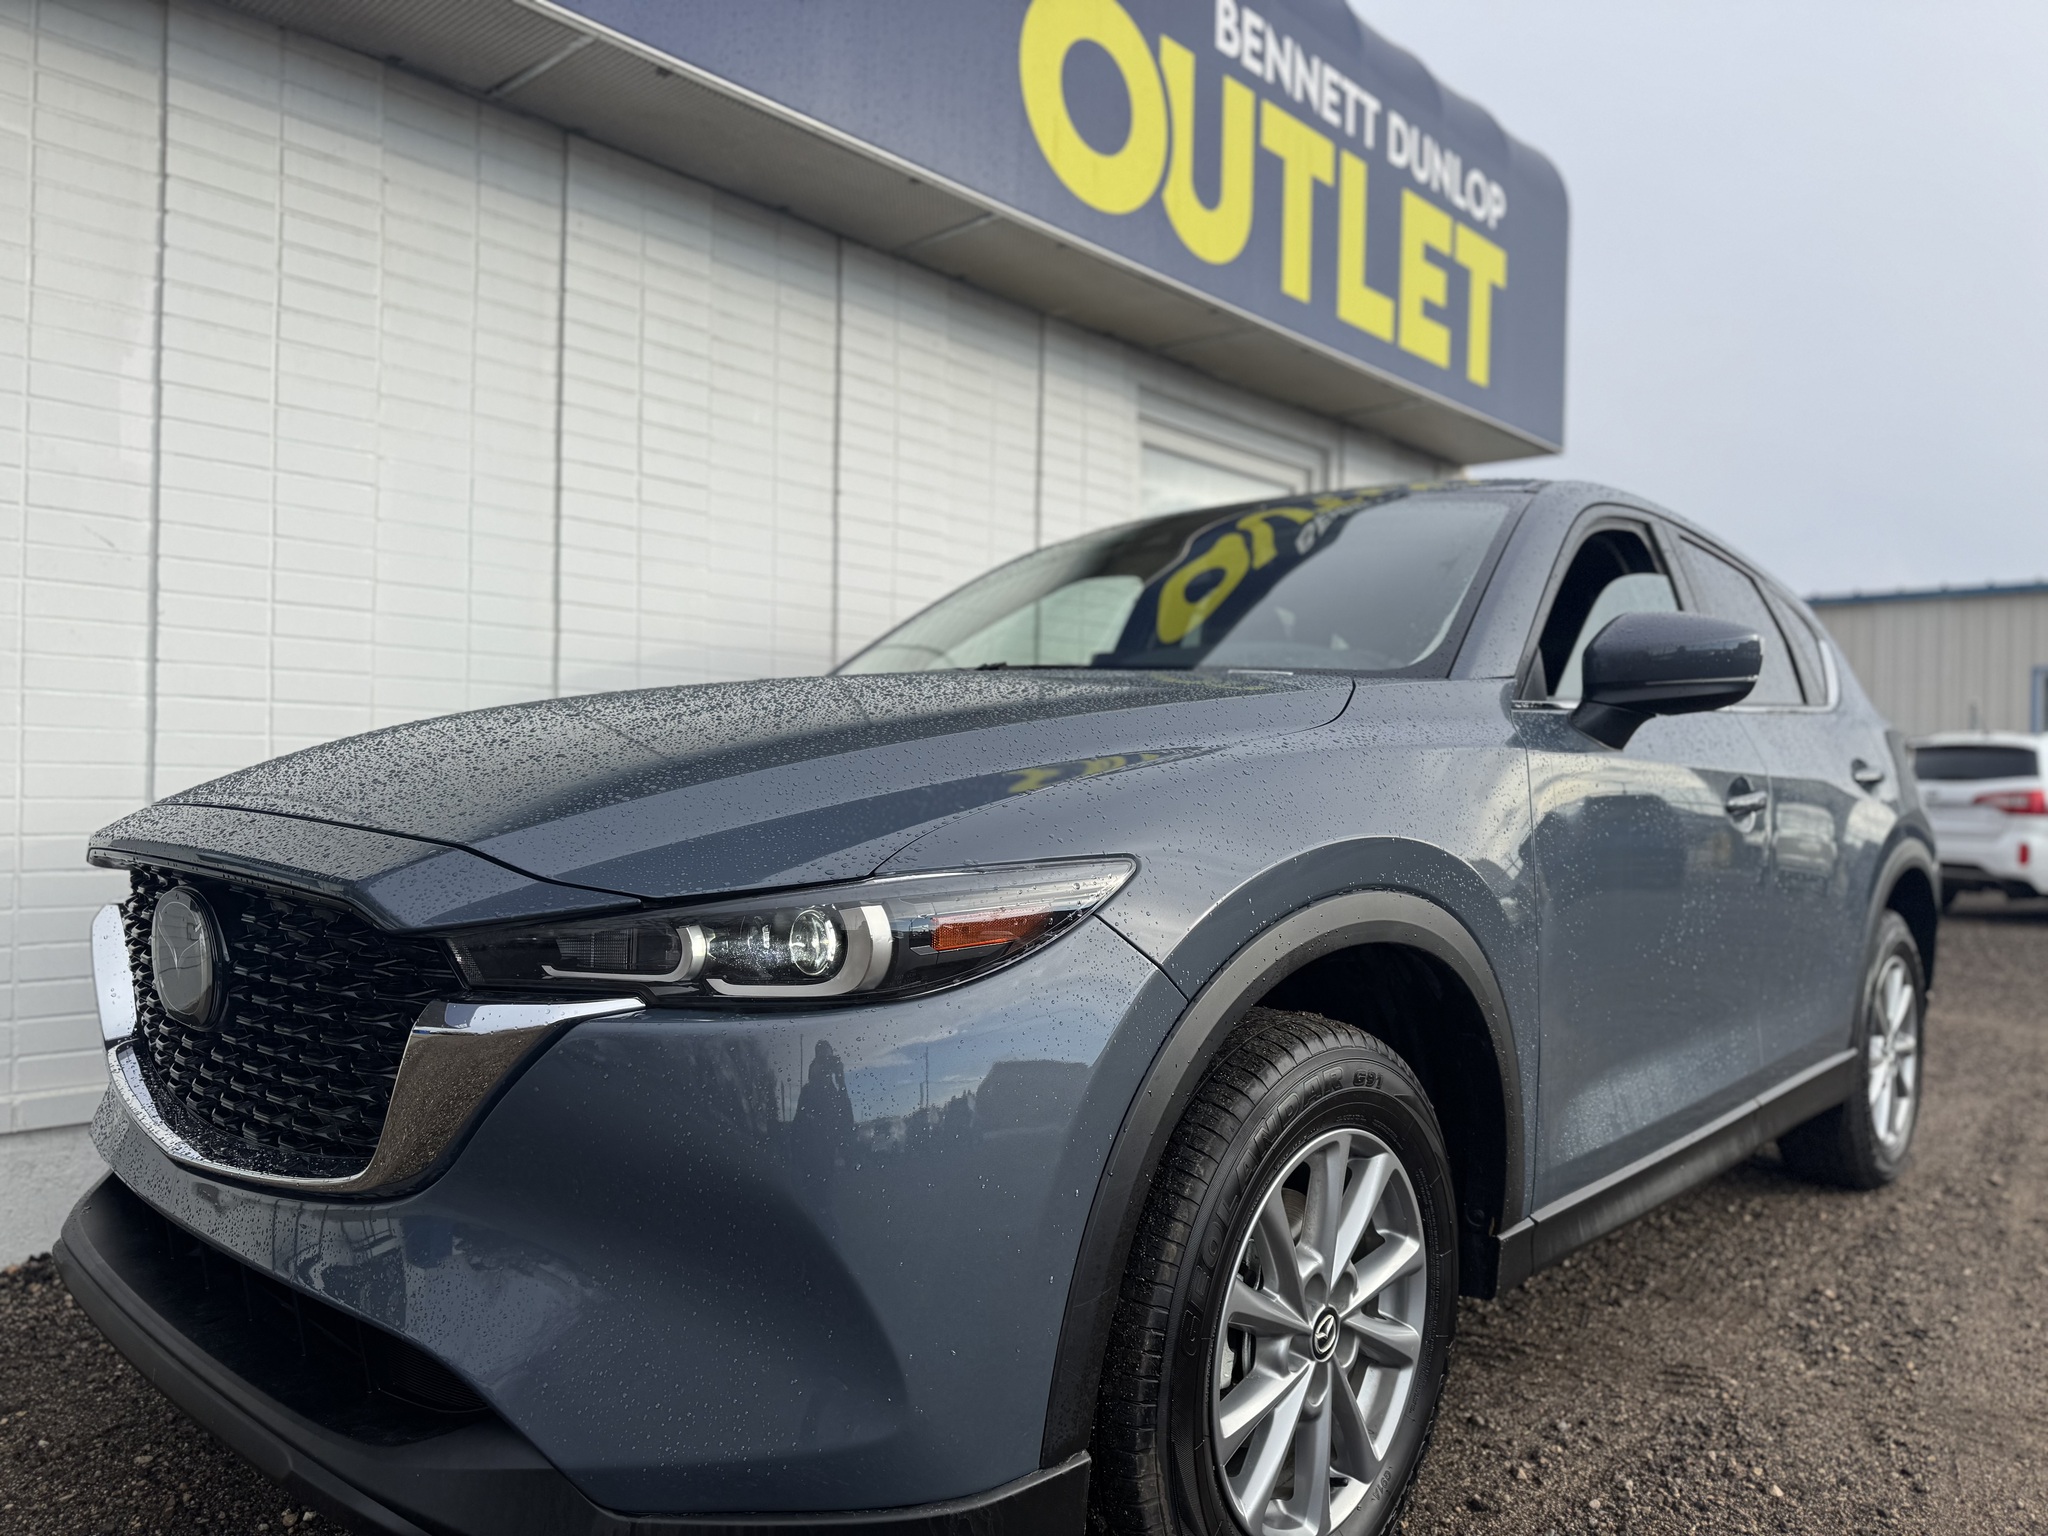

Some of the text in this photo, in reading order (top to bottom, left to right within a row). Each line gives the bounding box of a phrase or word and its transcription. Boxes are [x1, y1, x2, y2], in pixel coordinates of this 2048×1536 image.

[1019, 0, 1508, 389] OUTLET
[1214, 0, 1507, 230] BENNETT DUNLOP
[1179, 1066, 1344, 1357] GEOLANDAR
[1352, 1068, 1384, 1090] G91
